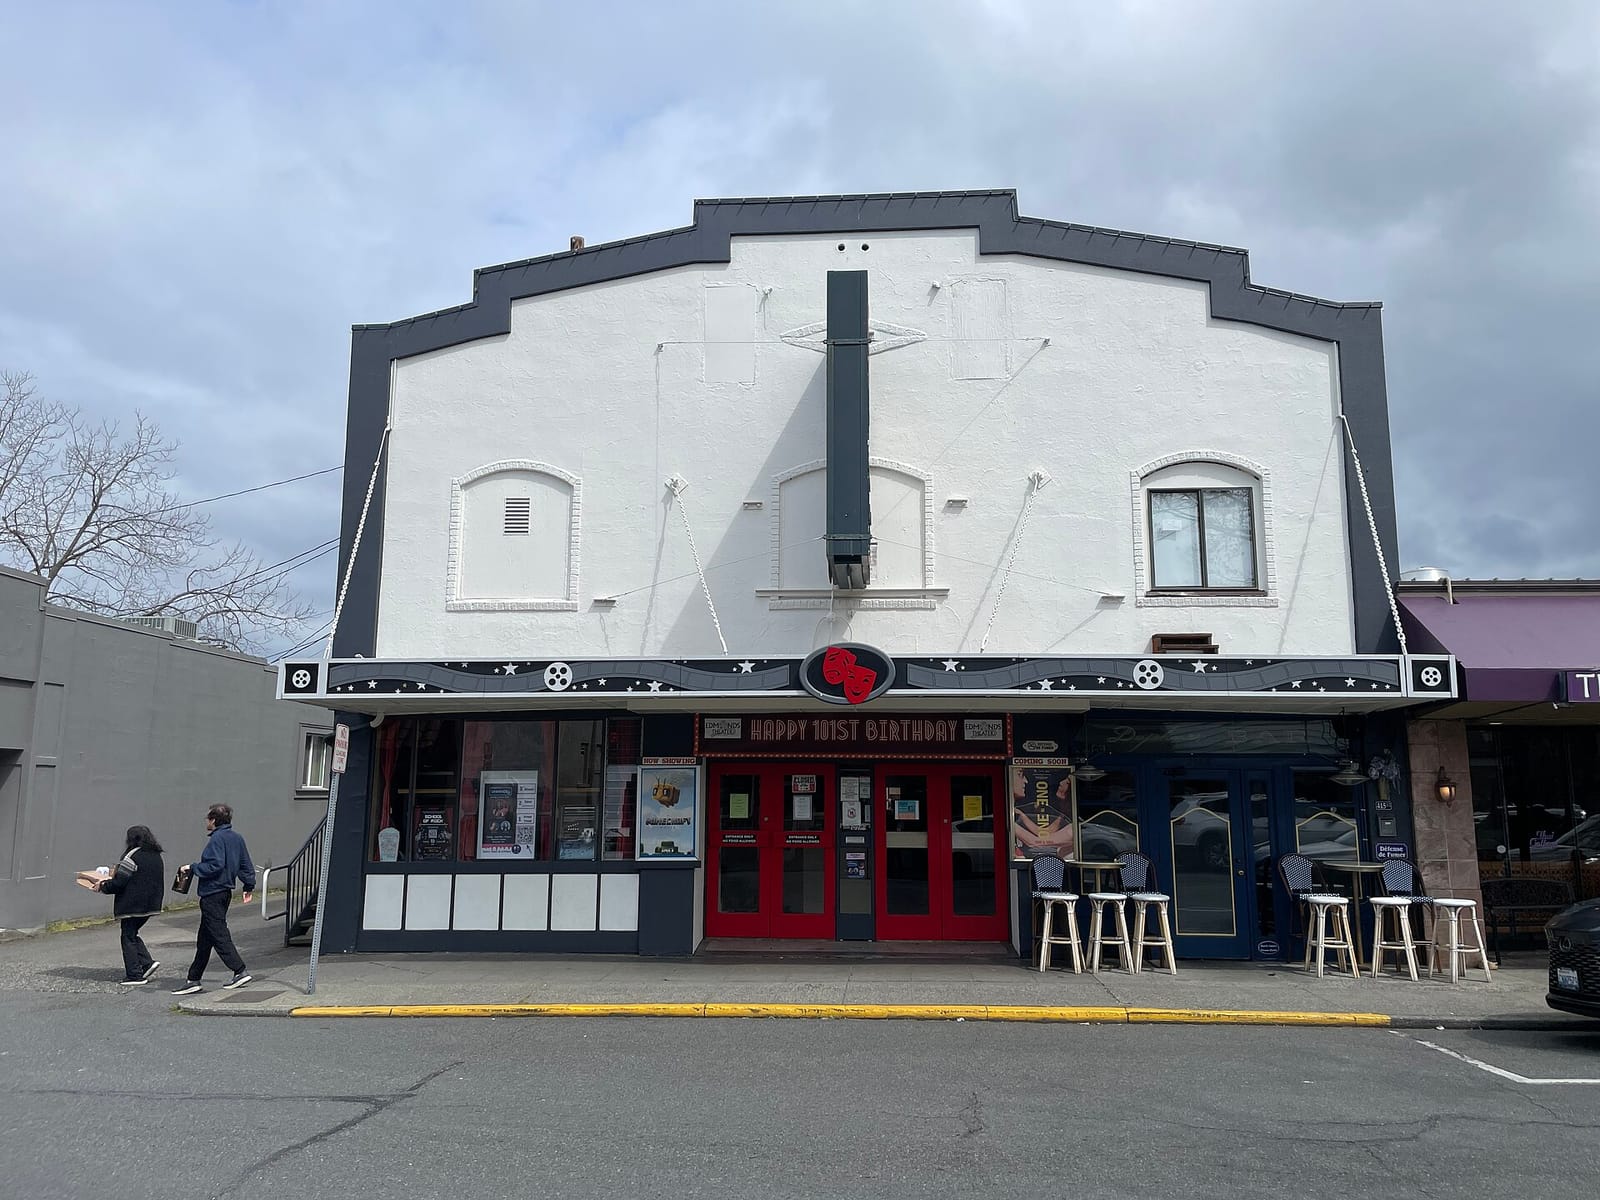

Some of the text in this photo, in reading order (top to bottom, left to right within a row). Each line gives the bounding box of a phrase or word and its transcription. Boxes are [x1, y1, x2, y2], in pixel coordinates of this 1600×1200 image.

[1575, 673, 1600, 698] T
[750, 719, 958, 742] HAPPY 101ST BIRTHDAY
[1036, 779, 1049, 807] ONE
[645, 816, 691, 826] MINECRAFT
